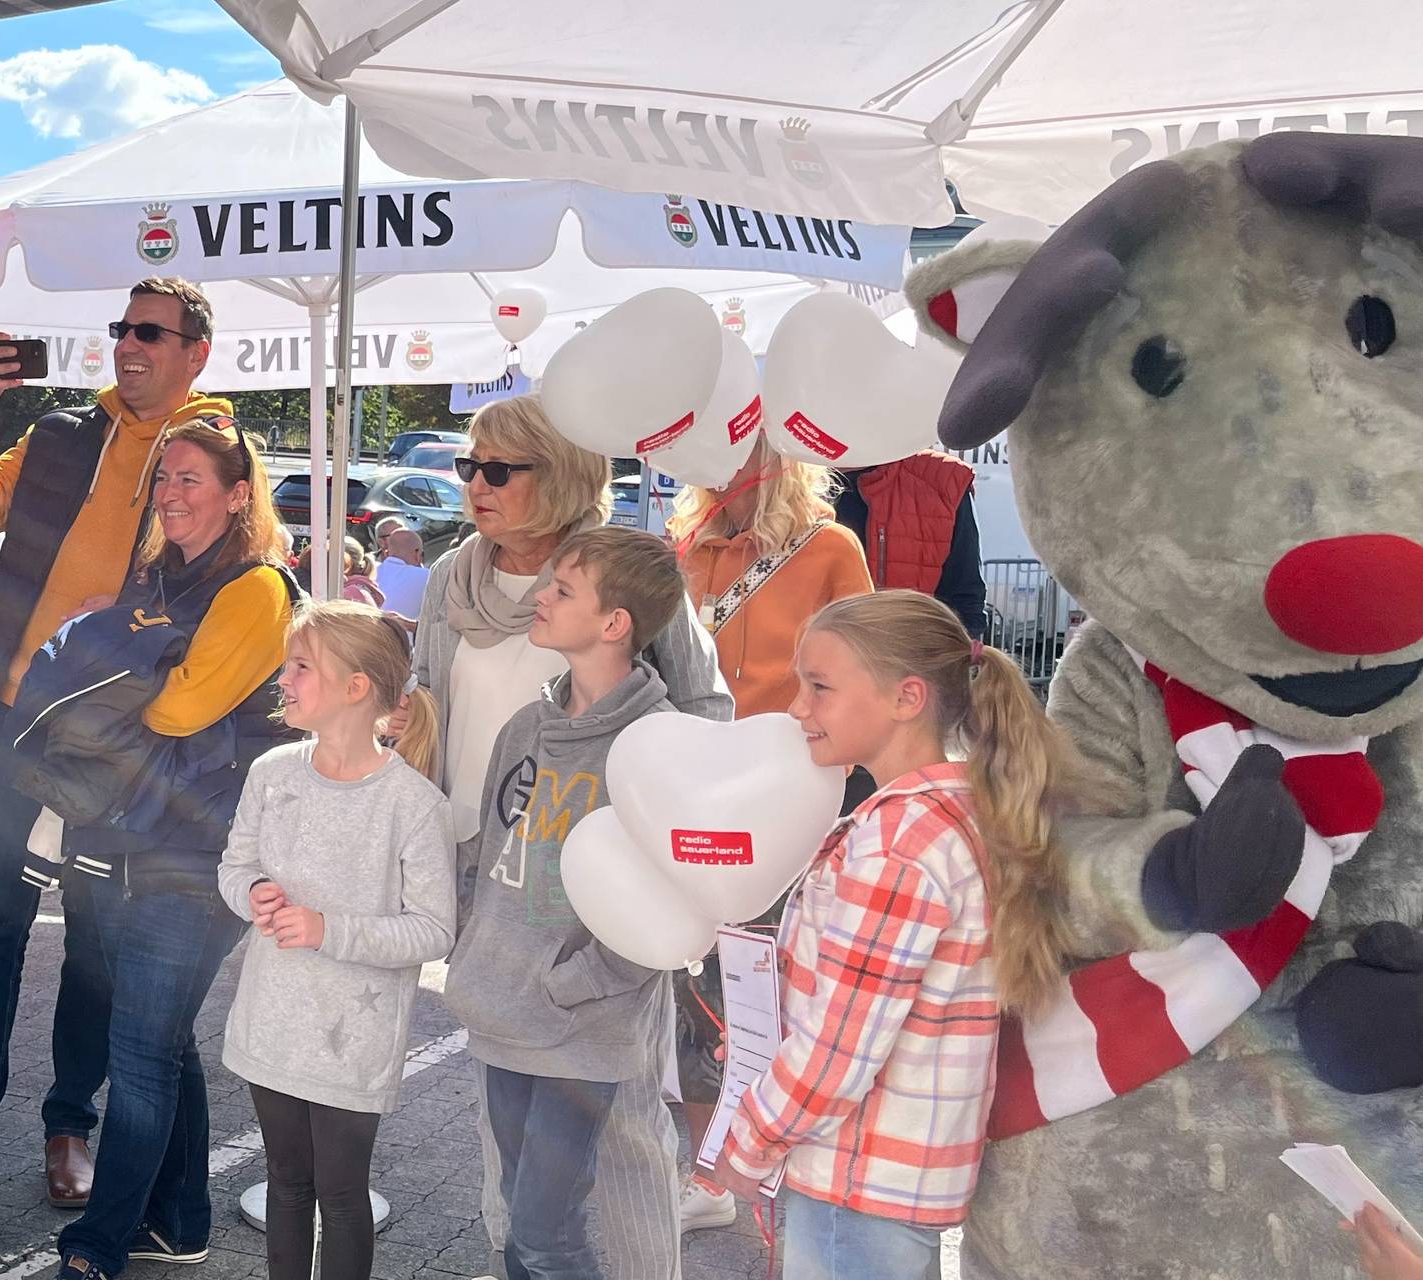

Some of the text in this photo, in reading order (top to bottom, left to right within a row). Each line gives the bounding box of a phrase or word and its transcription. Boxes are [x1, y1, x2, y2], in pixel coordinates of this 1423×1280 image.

[192, 191, 454, 257] VELTINS
[798, 419, 819, 438] radio
[679, 836, 711, 844] radio
[680, 846, 743, 855] sauerland
